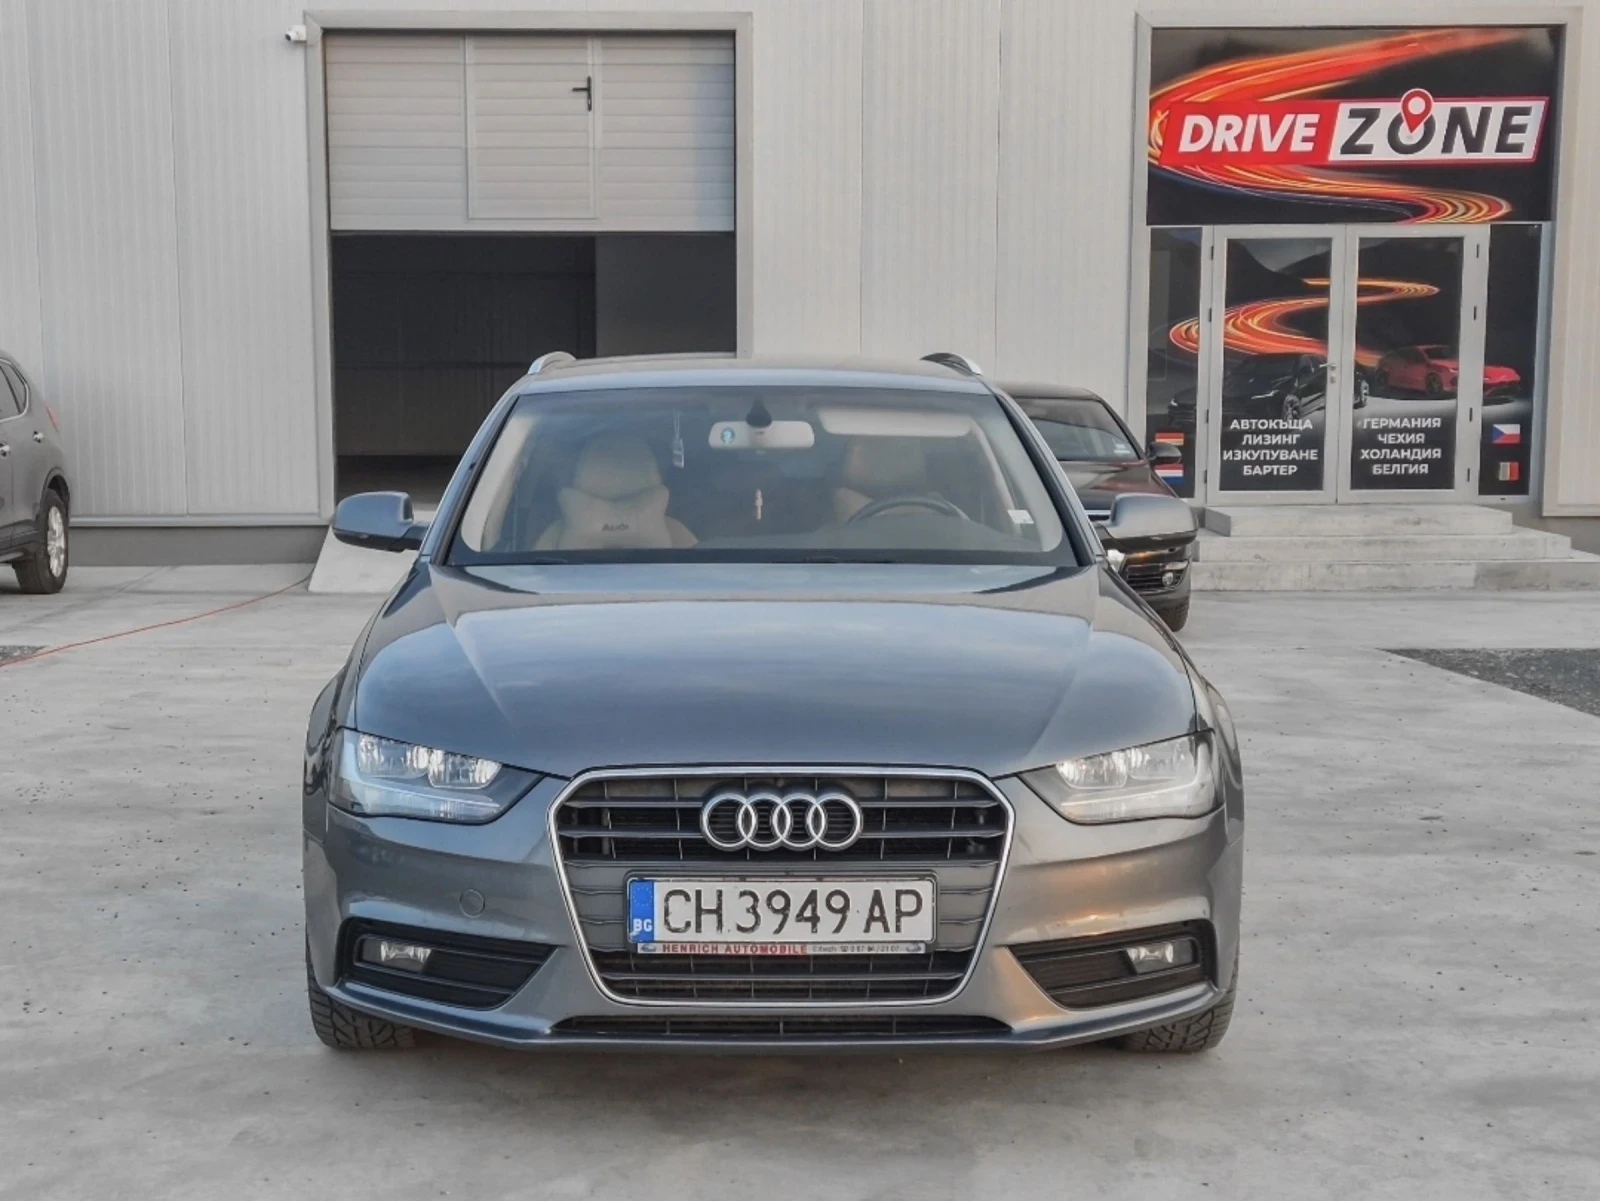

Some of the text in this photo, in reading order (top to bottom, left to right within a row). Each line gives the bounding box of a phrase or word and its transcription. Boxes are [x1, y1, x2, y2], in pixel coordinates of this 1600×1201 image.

[1178, 106, 1532, 155] DRIVE ZONE
[1230, 418, 1313, 431] АВТОКЪЩА
[1363, 417, 1442, 429] ГЕРМАНИЯ
[1241, 433, 1301, 445] ЛИЗИНГ
[1377, 432, 1426, 444] ЧЕХИЯ
[1222, 449, 1319, 461] ИЗКУПУВАНЕ
[1360, 448, 1442, 460] ХОЛАНДИЯ
[1243, 464, 1298, 476] БАРТЕР
[1372, 463, 1429, 475] БЕЛГИЯ
[663, 889, 923, 934] CH 3949 AP
[633, 918, 653, 932] BG
[662, 944, 719, 953] HENRICH
[725, 944, 808, 954] AUTOMOBILE
